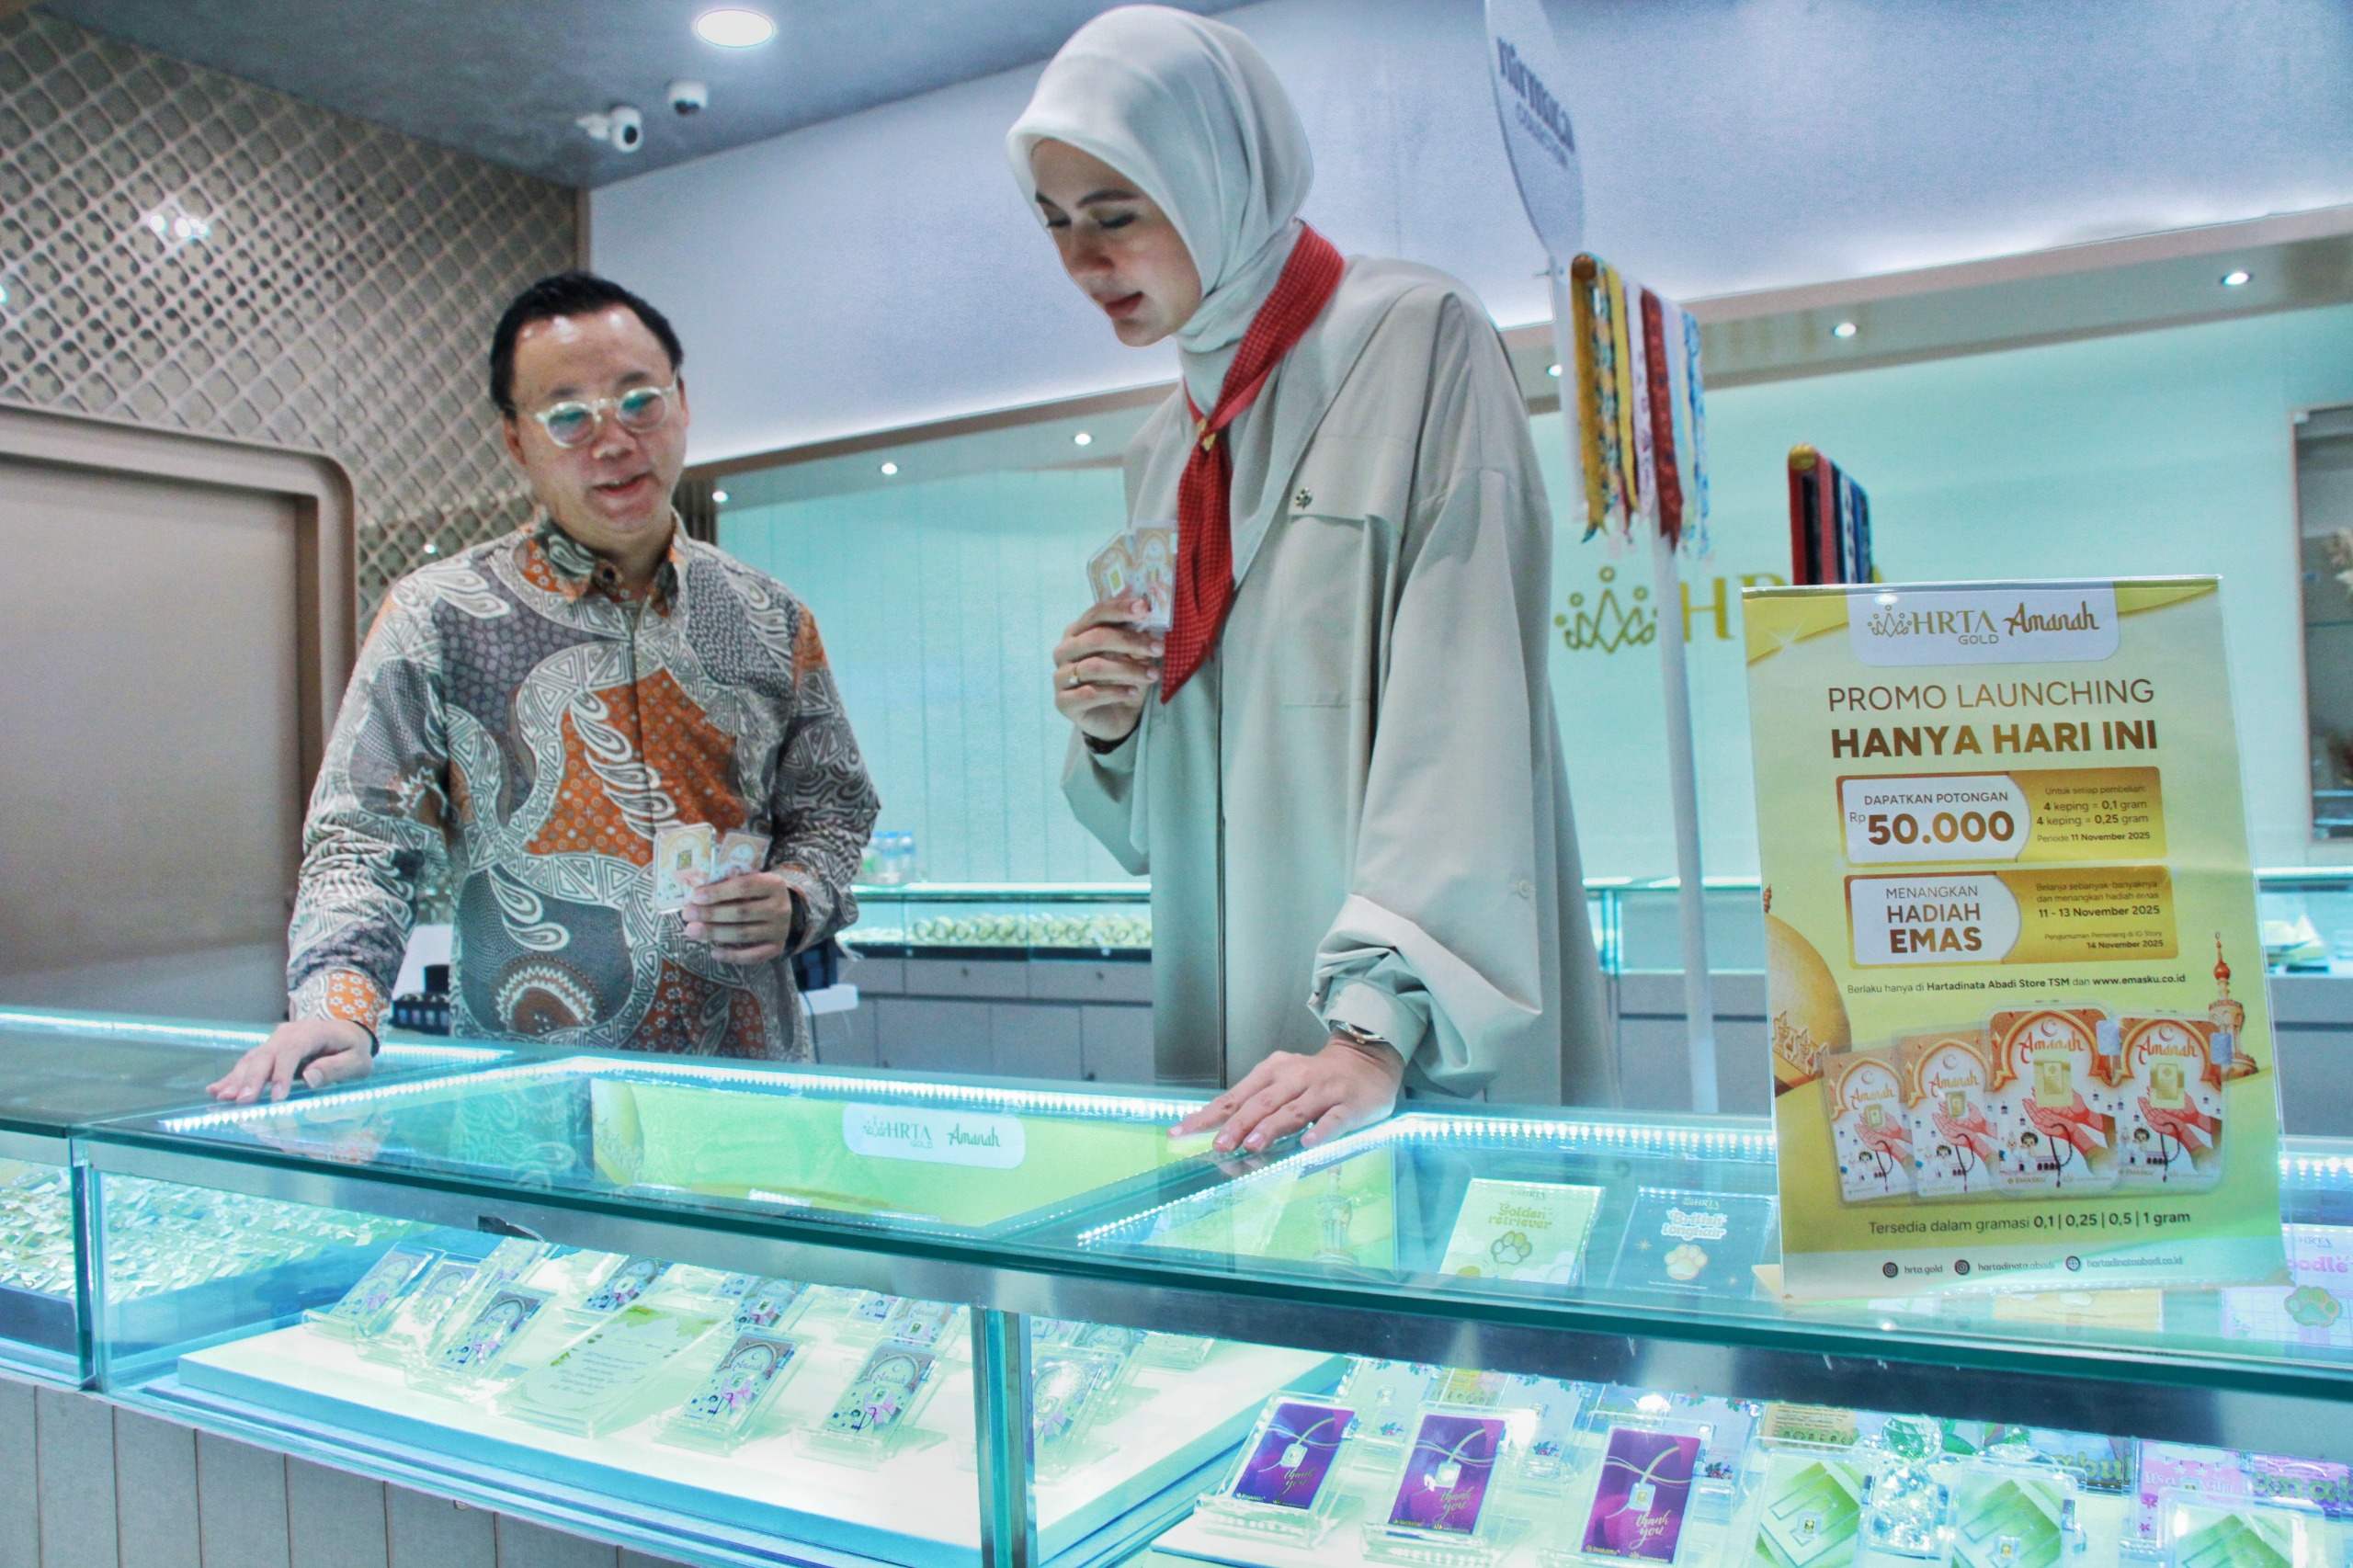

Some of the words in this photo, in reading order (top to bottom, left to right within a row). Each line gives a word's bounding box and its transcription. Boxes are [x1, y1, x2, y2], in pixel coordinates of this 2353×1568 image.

[1910, 609, 1998, 634] HRTA
[2003, 600, 2100, 636] Amanah
[1958, 634, 1999, 645] GOLD
[1828, 684, 1947, 711] PROMO
[1957, 678, 2154, 708] LAUNCHING
[1831, 726, 1983, 758] HANYA
[1993, 722, 2091, 754] HARI
[2102, 720, 2157, 750] INI
[1864, 793, 1933, 806] DAPATKAN
[1936, 791, 2008, 803] POTONGAN
[2045, 787, 2071, 796] Untuk
[2073, 786, 2097, 796] setiap
[2043, 801, 2052, 811] 4
[2053, 801, 2089, 812] keping
[2101, 800, 2118, 812] 0,1
[2120, 801, 2147, 812] gram
[2036, 816, 2044, 825] 4
[2046, 815, 2082, 827] keping
[2094, 813, 2119, 825] 0,25
[2121, 814, 2149, 825] gram
[1849, 812, 1866, 824] Rp
[1868, 811, 2015, 846] 50.000
[2037, 834, 2069, 843] Periode
[2081, 832, 2125, 842] November
[2128, 832, 2151, 840] 2025
[1886, 885, 1978, 899] MENANGKAN
[2036, 894, 2052, 903] dan
[2054, 893, 2104, 903] menangkan
[2105, 892, 2133, 901] hadiah
[1887, 903, 1981, 924] HADIAH
[2039, 909, 2049, 918] 11
[2059, 908, 2070, 917] 13
[2073, 906, 2130, 917] November
[2131, 905, 2160, 915] 2025
[1890, 926, 1983, 954] EMAS
[2098, 940, 2141, 949] November
[2143, 939, 2164, 948] 2025
[1847, 984, 1882, 994] Berlaku
[1884, 983, 1914, 994] hanya
[1915, 983, 1925, 992] di
[1927, 982, 1985, 992] Hartadinata
[1988, 979, 2017, 989] Abadi
[2018, 979, 2046, 988] Store
[2048, 977, 2070, 986] TSM
[2072, 978, 2091, 986] dan
[2092, 974, 2186, 986] www.emasku.co.id
[887, 1122, 932, 1141] HRTA
[947, 1123, 1001, 1147] Amanah
[1499, 1202, 1546, 1220] Golden
[1488, 1215, 1552, 1229] retriever
[1869, 1221, 1927, 1234] Tersedia
[1930, 1220, 1972, 1233] dalam
[1975, 1216, 2029, 1233] gramasi
[2033, 1215, 2054, 1229] 0,1
[2065, 1213, 2097, 1228] 0,25
[2109, 1212, 2131, 1226] 0,5
[2143, 1212, 2149, 1223] 1
[2153, 1212, 2190, 1227] gram
